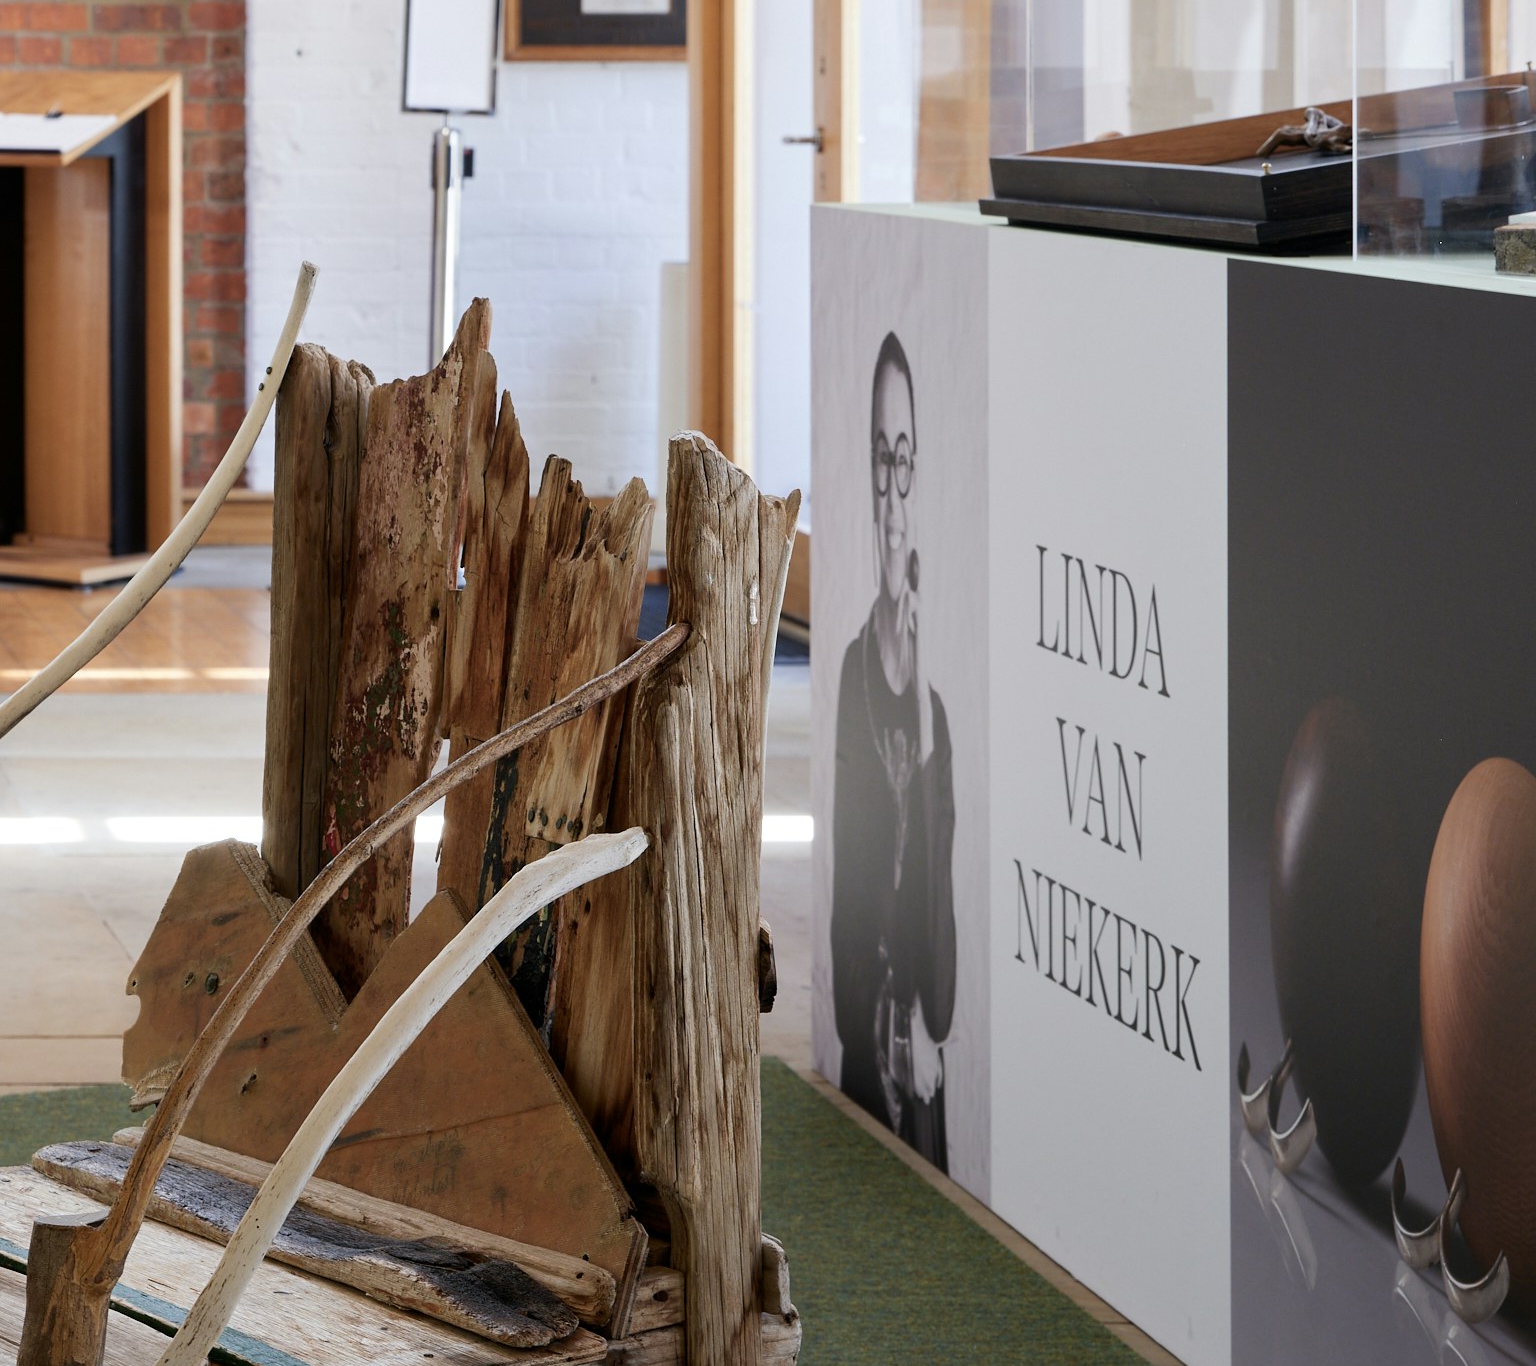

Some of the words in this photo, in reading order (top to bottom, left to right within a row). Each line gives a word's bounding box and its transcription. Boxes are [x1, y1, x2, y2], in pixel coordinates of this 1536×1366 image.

[1037, 545, 1170, 698] LINDA
[1057, 717, 1146, 860] VAN
[1015, 860, 1202, 1071] NIEKERK
